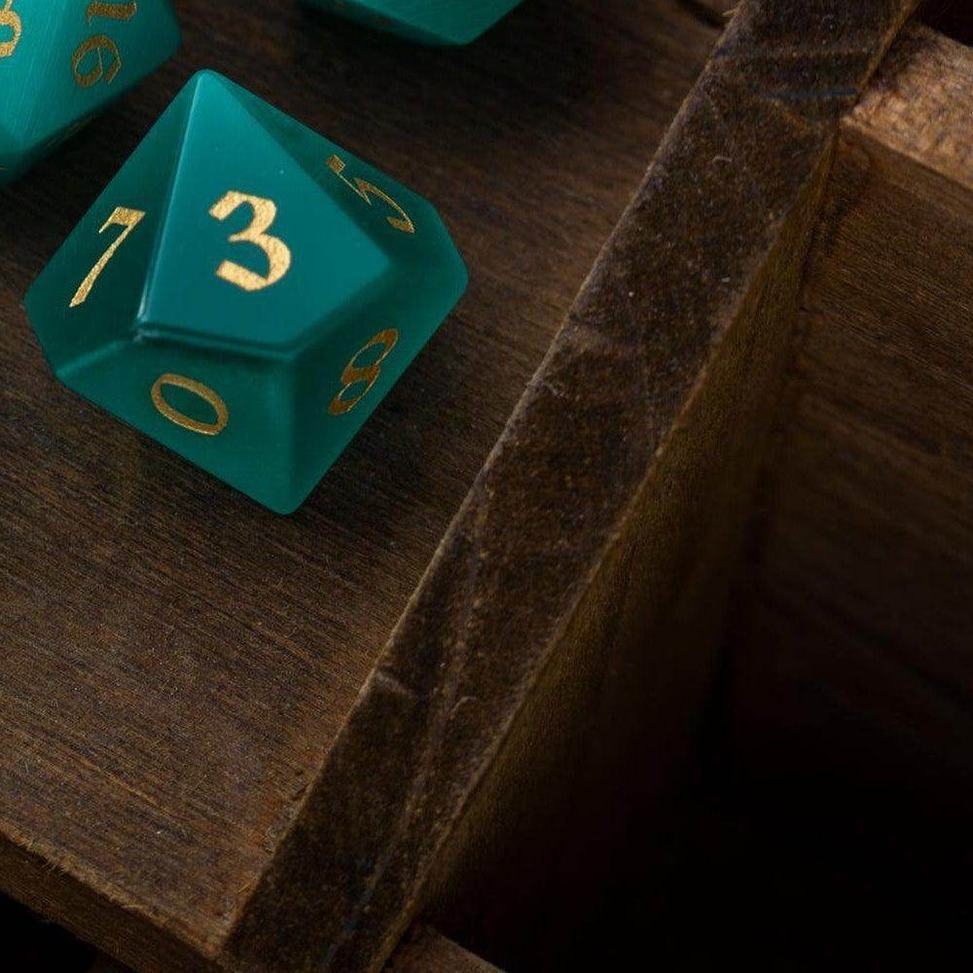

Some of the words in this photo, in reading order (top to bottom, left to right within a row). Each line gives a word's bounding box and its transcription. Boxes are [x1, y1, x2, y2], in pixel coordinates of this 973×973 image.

[327, 154, 415, 233] 5
[69, 206, 146, 308] 7
[208, 190, 292, 291] 3
[151, 373, 228, 436] 0
[328, 328, 399, 416] 8
